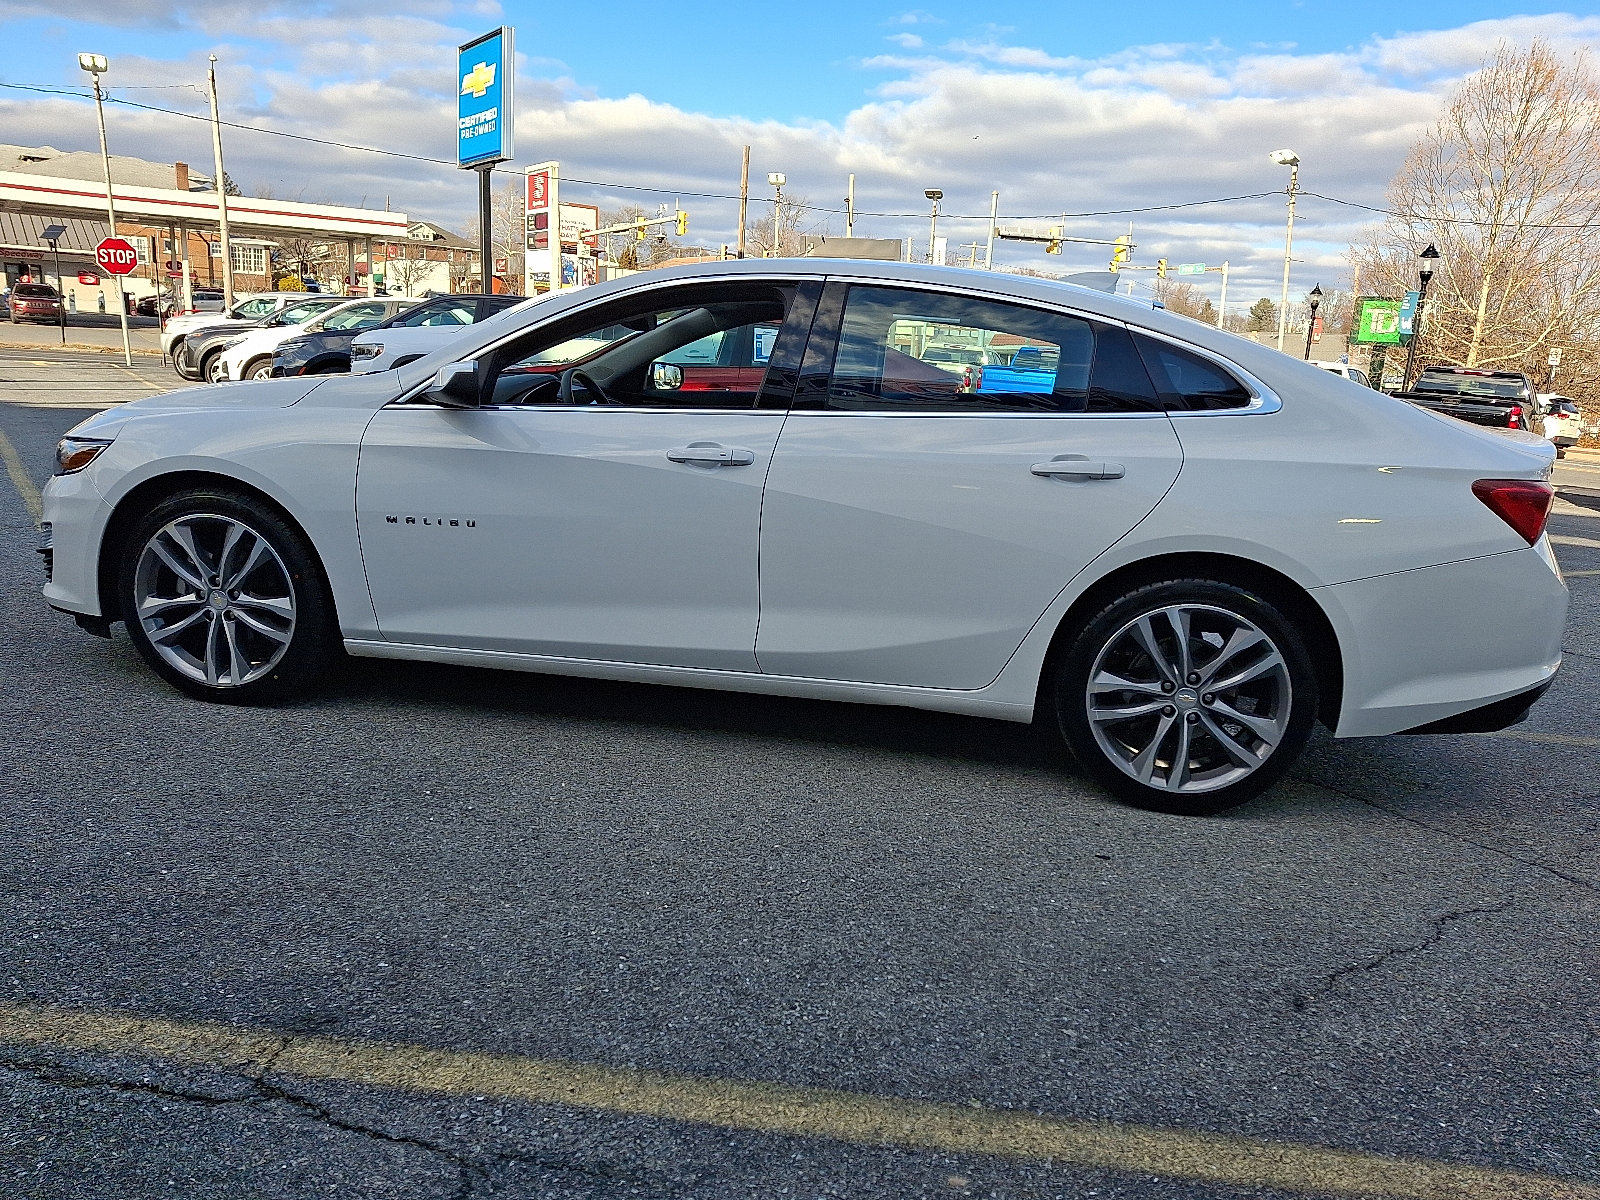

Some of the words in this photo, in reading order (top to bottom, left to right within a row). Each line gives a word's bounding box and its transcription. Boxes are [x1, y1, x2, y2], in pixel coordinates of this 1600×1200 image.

[459, 107, 498, 129] CERTIFIED
[461, 120, 496, 140] PRE-OWNED
[0, 249, 44, 260] Speedway
[99, 248, 135, 264] STOP
[1366, 308, 1399, 334] TD
[386, 515, 476, 528] MALIBU
